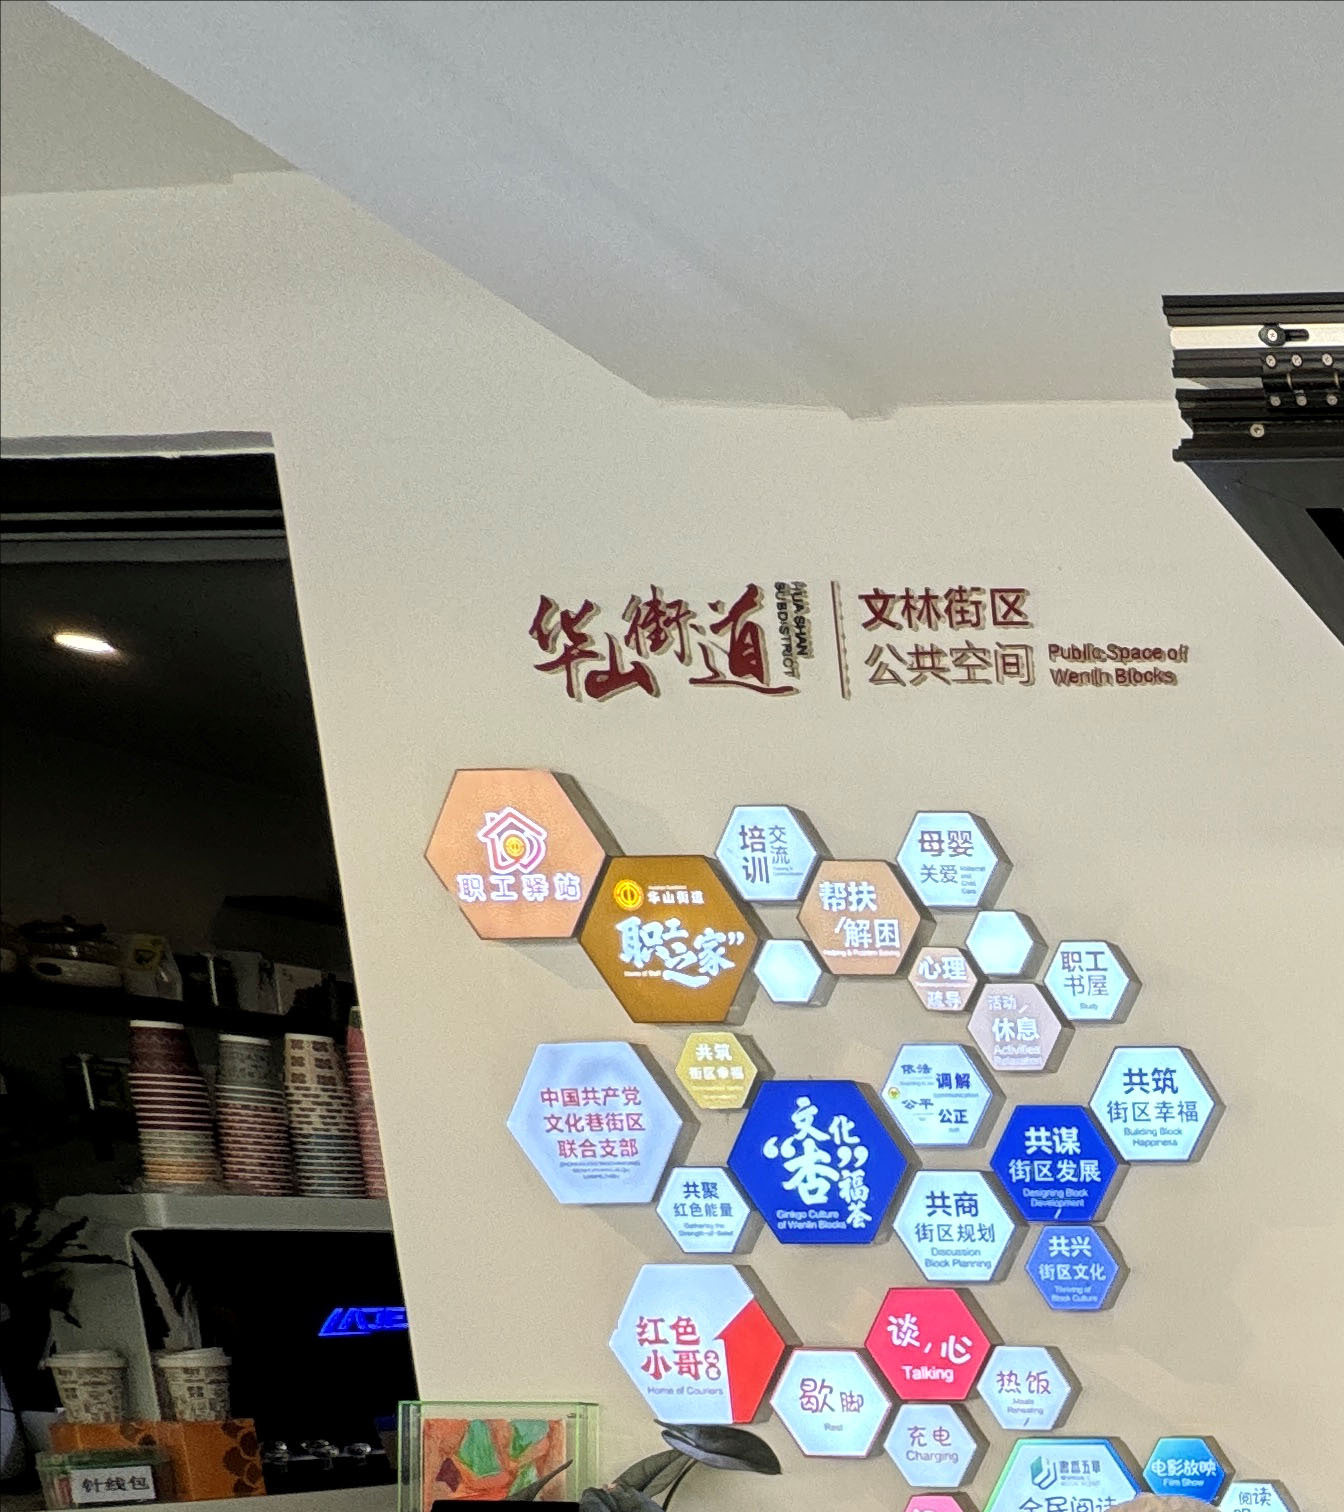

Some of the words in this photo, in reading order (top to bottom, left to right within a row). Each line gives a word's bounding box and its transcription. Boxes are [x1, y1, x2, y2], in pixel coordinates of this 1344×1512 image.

[858, 586, 1033, 630] 文林街区
[529, 583, 799, 699] 华山街道
[867, 642, 1034, 686] 公共空间
[1048, 643, 1104, 661] Public
[1106, 643, 1163, 664] Space
[1115, 667, 1177, 686] Blocks
[739, 825, 769, 883] 培训
[768, 825, 790, 864] 交流
[918, 830, 974, 857] 母婴
[920, 864, 958, 884] 关爱
[456, 873, 582, 902] 职工驿站
[819, 881, 877, 912] 帮扶
[918, 955, 967, 980] 心理
[1060, 951, 1108, 972] 职工
[1064, 974, 1109, 996] 书屋
[987, 994, 1017, 1010] 活动
[992, 1016, 1040, 1042] 休息
[936, 1072, 971, 1089] 调解
[1123, 1067, 1179, 1094] 共筑
[540, 1086, 642, 1108] 中国共产党
[901, 1098, 934, 1109] 公平
[543, 1112, 646, 1133] 文化巷街区
[938, 1109, 969, 1124] 公正
[1107, 1100, 1199, 1123] 街区幸福
[557, 1138, 639, 1158] 联合支部
[1024, 1126, 1081, 1155] 共谋
[1008, 1159, 1102, 1182] 街区发展
[683, 1181, 719, 1199] 共聚
[673, 1202, 734, 1217] 红色能量
[926, 1190, 979, 1217] 共商
[914, 1223, 996, 1243] 街区规划
[1048, 1235, 1092, 1257] 共兴
[1038, 1263, 1107, 1281] 街区文化
[636, 1315, 701, 1346] 红色
[641, 1349, 704, 1381] 小哥
[901, 1364, 954, 1383] Talking
[996, 1370, 1051, 1394] 热饭
[799, 1378, 864, 1413] 歇脚
[907, 1425, 952, 1447] 充电
[905, 1450, 959, 1464] Charging
[1151, 1459, 1217, 1477] 电影放映
[81, 1475, 150, 1493] 针线包
[1239, 1487, 1272, 1506] 阅读
